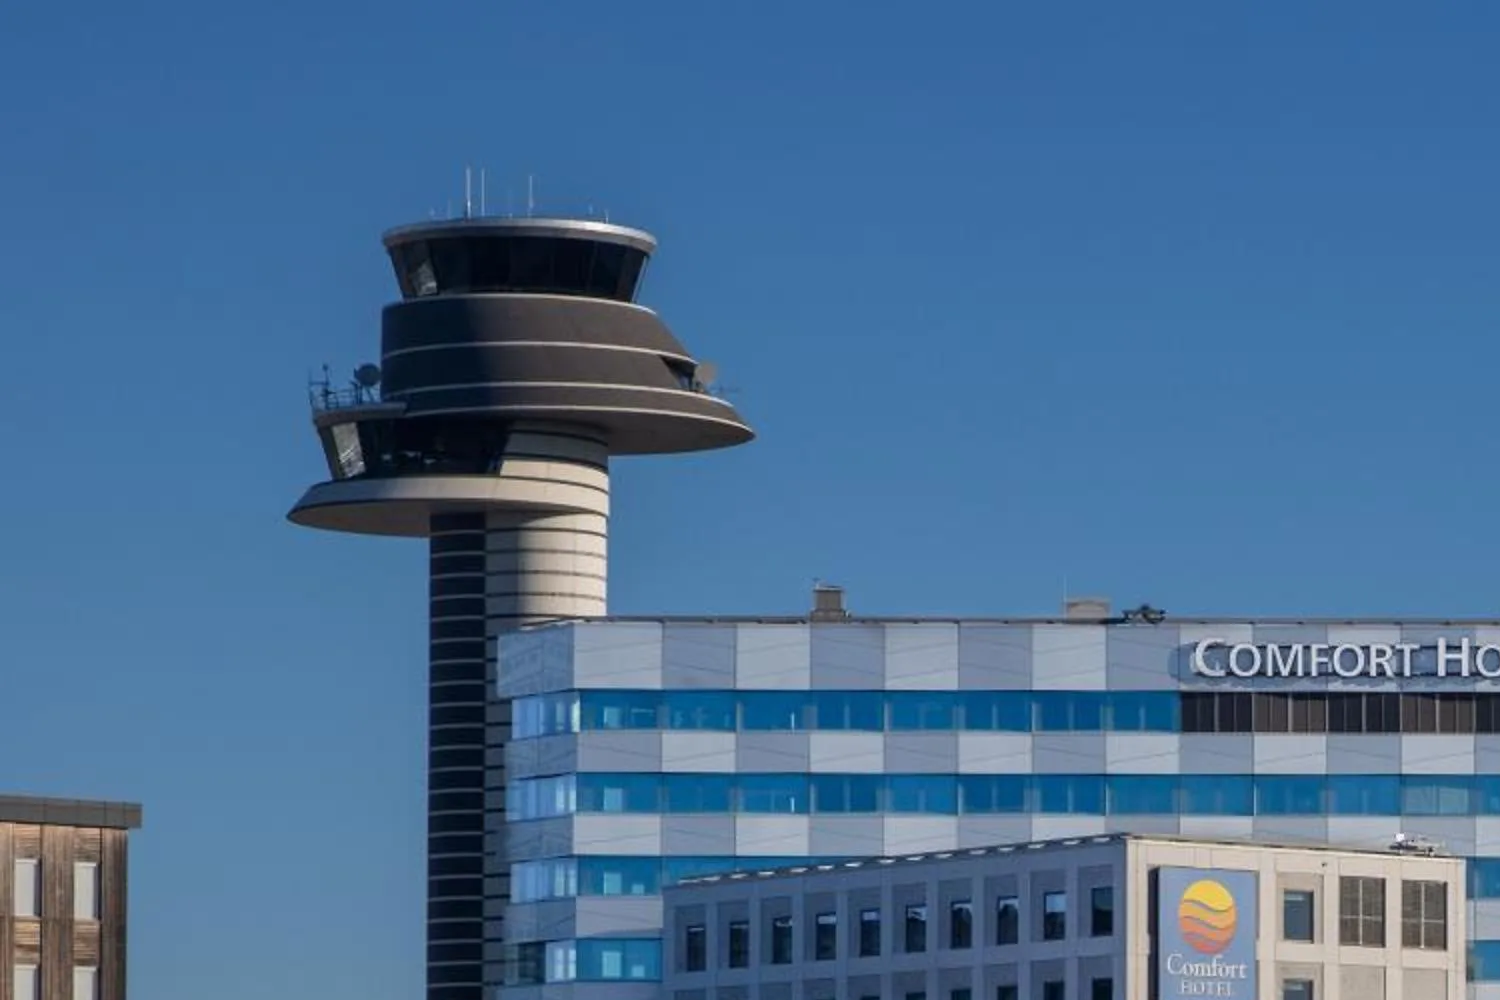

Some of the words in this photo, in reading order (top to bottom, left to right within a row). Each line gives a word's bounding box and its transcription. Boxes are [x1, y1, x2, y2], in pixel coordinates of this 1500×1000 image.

[1195, 637, 1420, 677] COMFORT
[1167, 953, 1248, 979] Comfort
[1179, 980, 1233, 997] HOTEL
